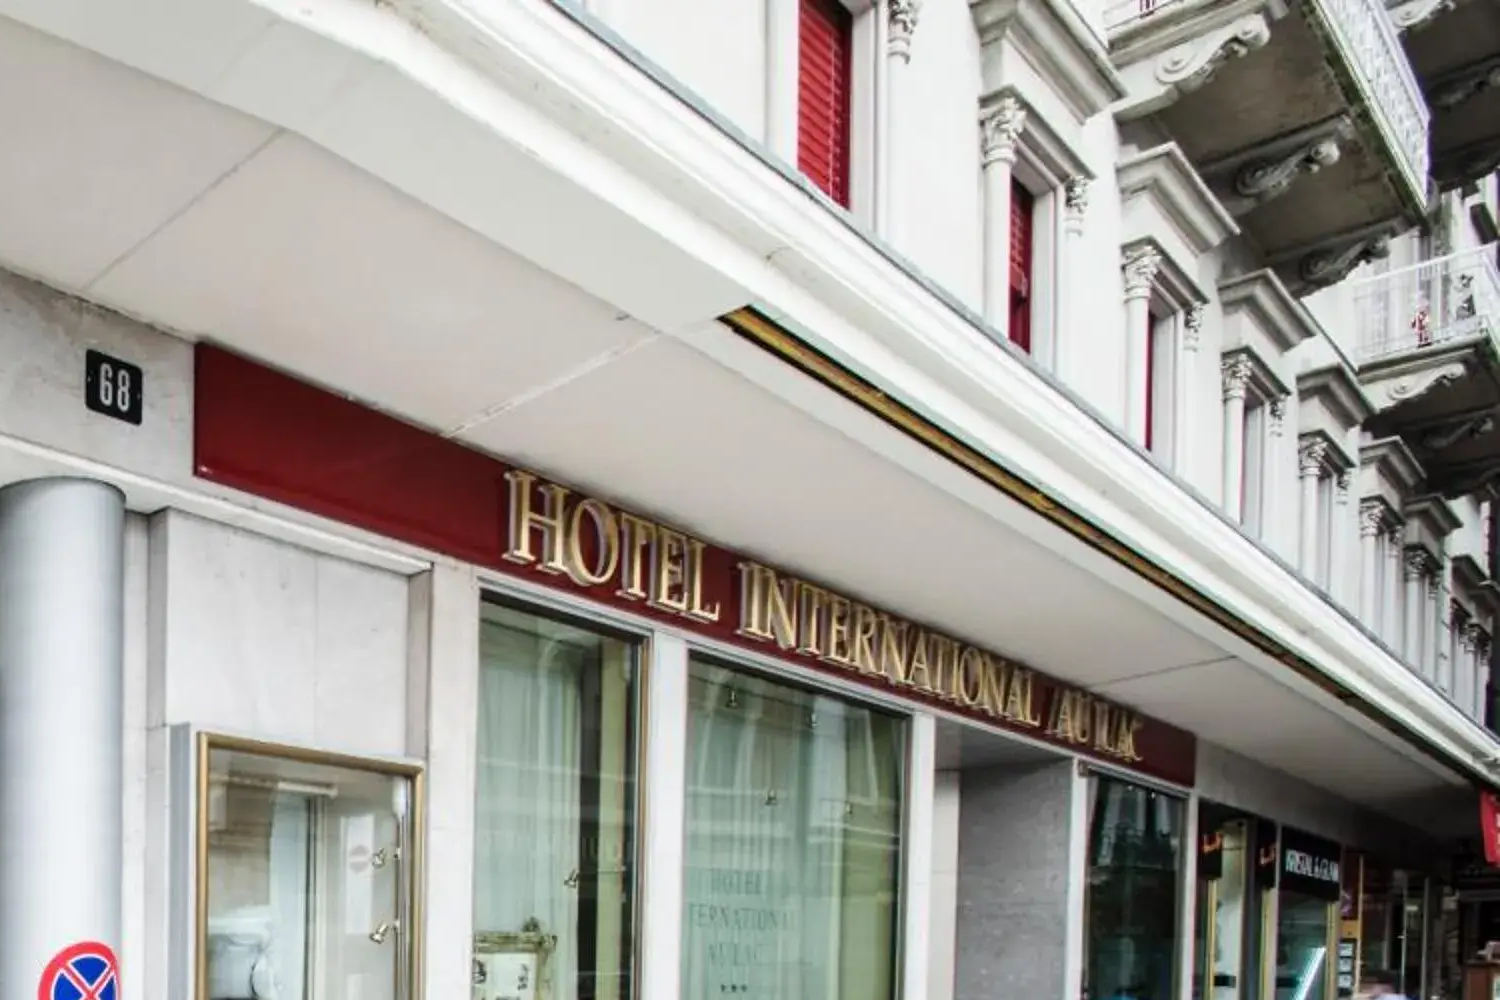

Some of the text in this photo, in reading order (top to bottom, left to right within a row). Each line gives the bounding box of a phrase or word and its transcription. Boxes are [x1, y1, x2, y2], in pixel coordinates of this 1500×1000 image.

[100, 362, 130, 412] 68
[501, 469, 720, 624] HOTEL
[736, 560, 1041, 727] INTERNATIONAL
